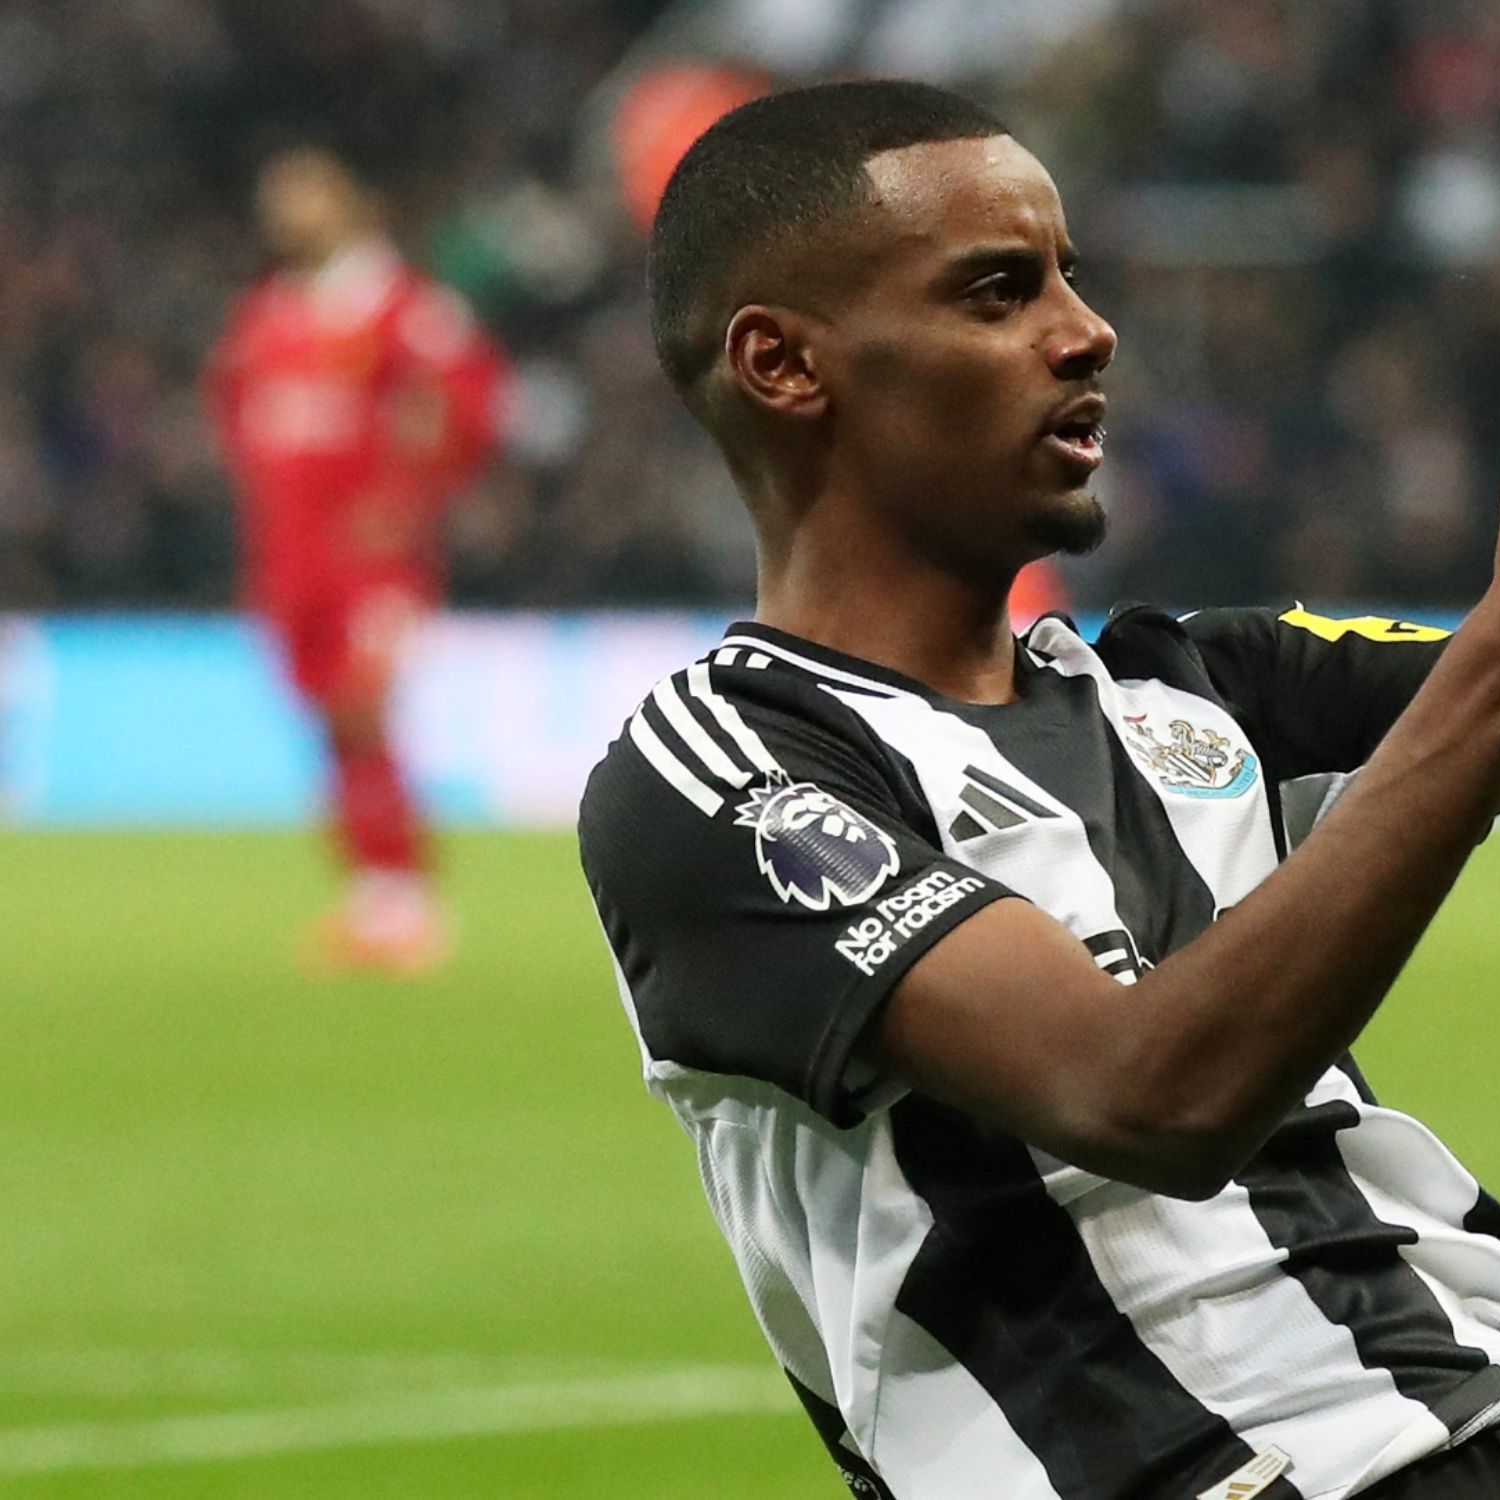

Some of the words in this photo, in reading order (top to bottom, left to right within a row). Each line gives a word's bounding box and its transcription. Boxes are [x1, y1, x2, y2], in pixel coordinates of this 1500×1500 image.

[835, 918, 883, 961] No
[876, 871, 955, 922] room
[854, 931, 897, 976] for
[894, 877, 985, 938] racism
